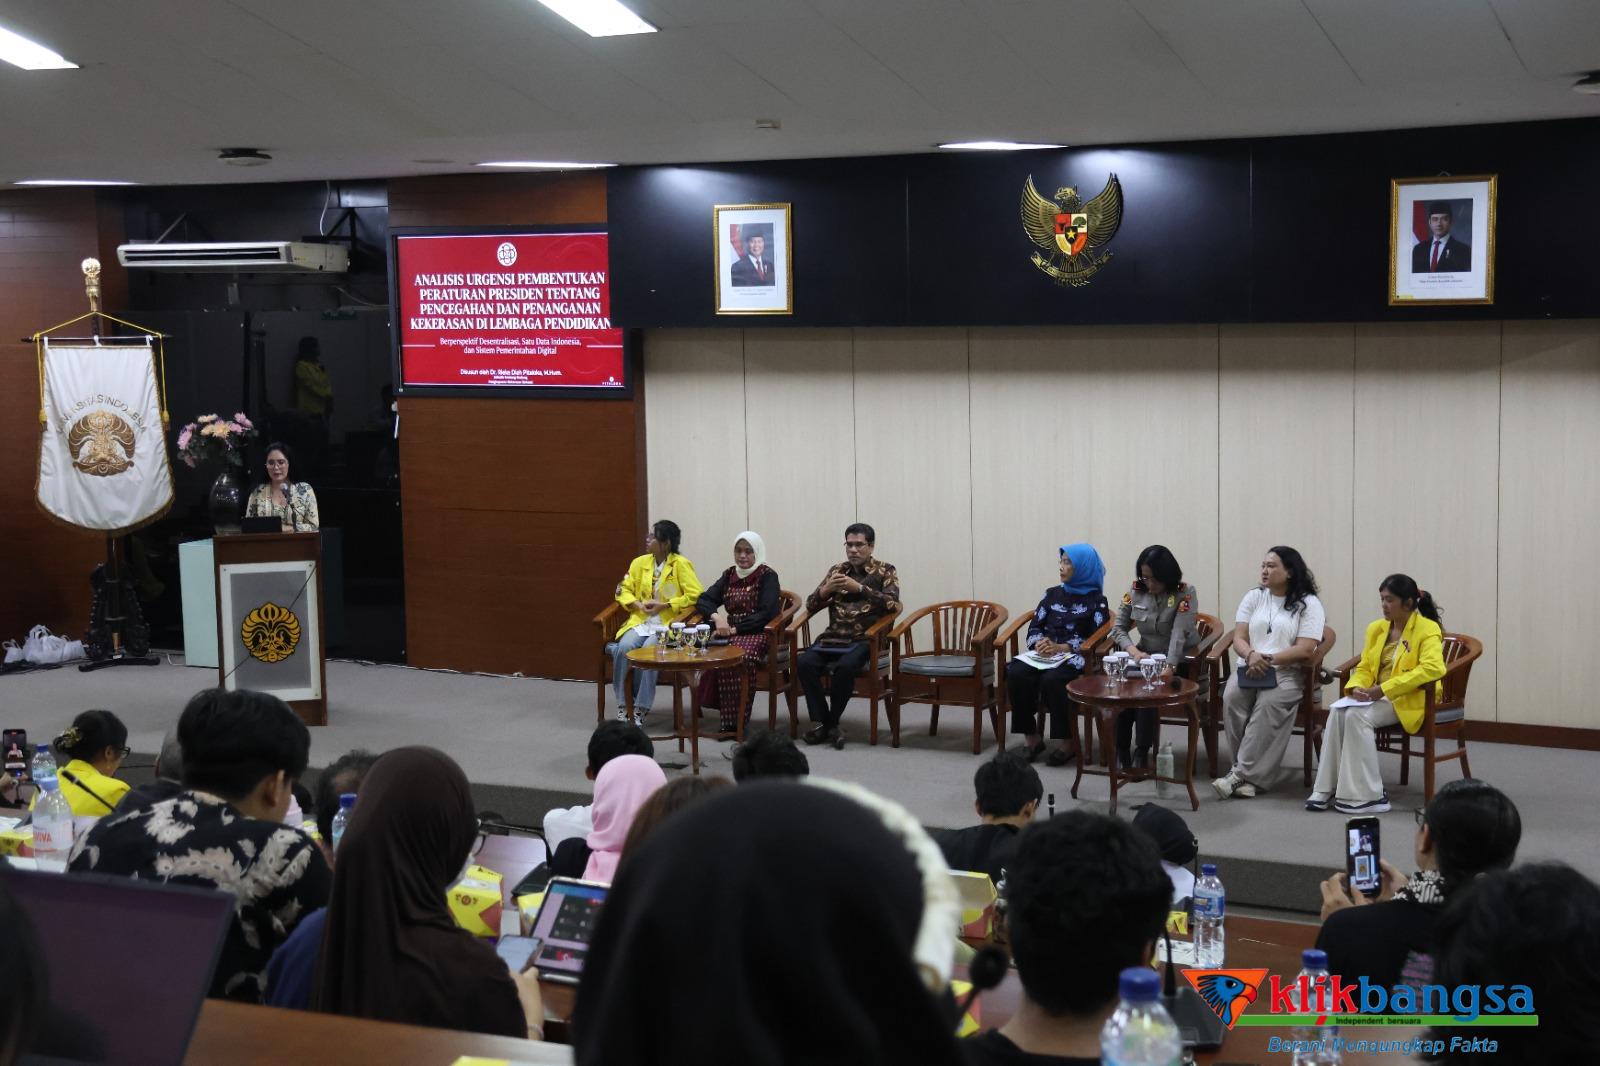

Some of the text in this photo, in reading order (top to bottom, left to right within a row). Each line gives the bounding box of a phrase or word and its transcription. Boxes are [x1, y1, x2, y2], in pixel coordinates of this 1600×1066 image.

[414, 272, 605, 287] ANALISIS URGENSI PEMBENTUKAN
[419, 286, 600, 301] PERATURAN PRESIDEN TENTANG
[419, 302, 601, 315] PENCEGAHAN DAN PENANGANAN
[410, 317, 474, 330] KEKERASAN
[475, 317, 488, 330] DI
[489, 317, 542, 330] LEMBAGA
[440, 337, 479, 347] Berperspektif
[521, 337, 534, 346] Satu
[535, 337, 550, 346] Data
[551, 337, 582, 346] Indonesia,
[463, 346, 557, 357] dan Sistem Pemerintahan Digital
